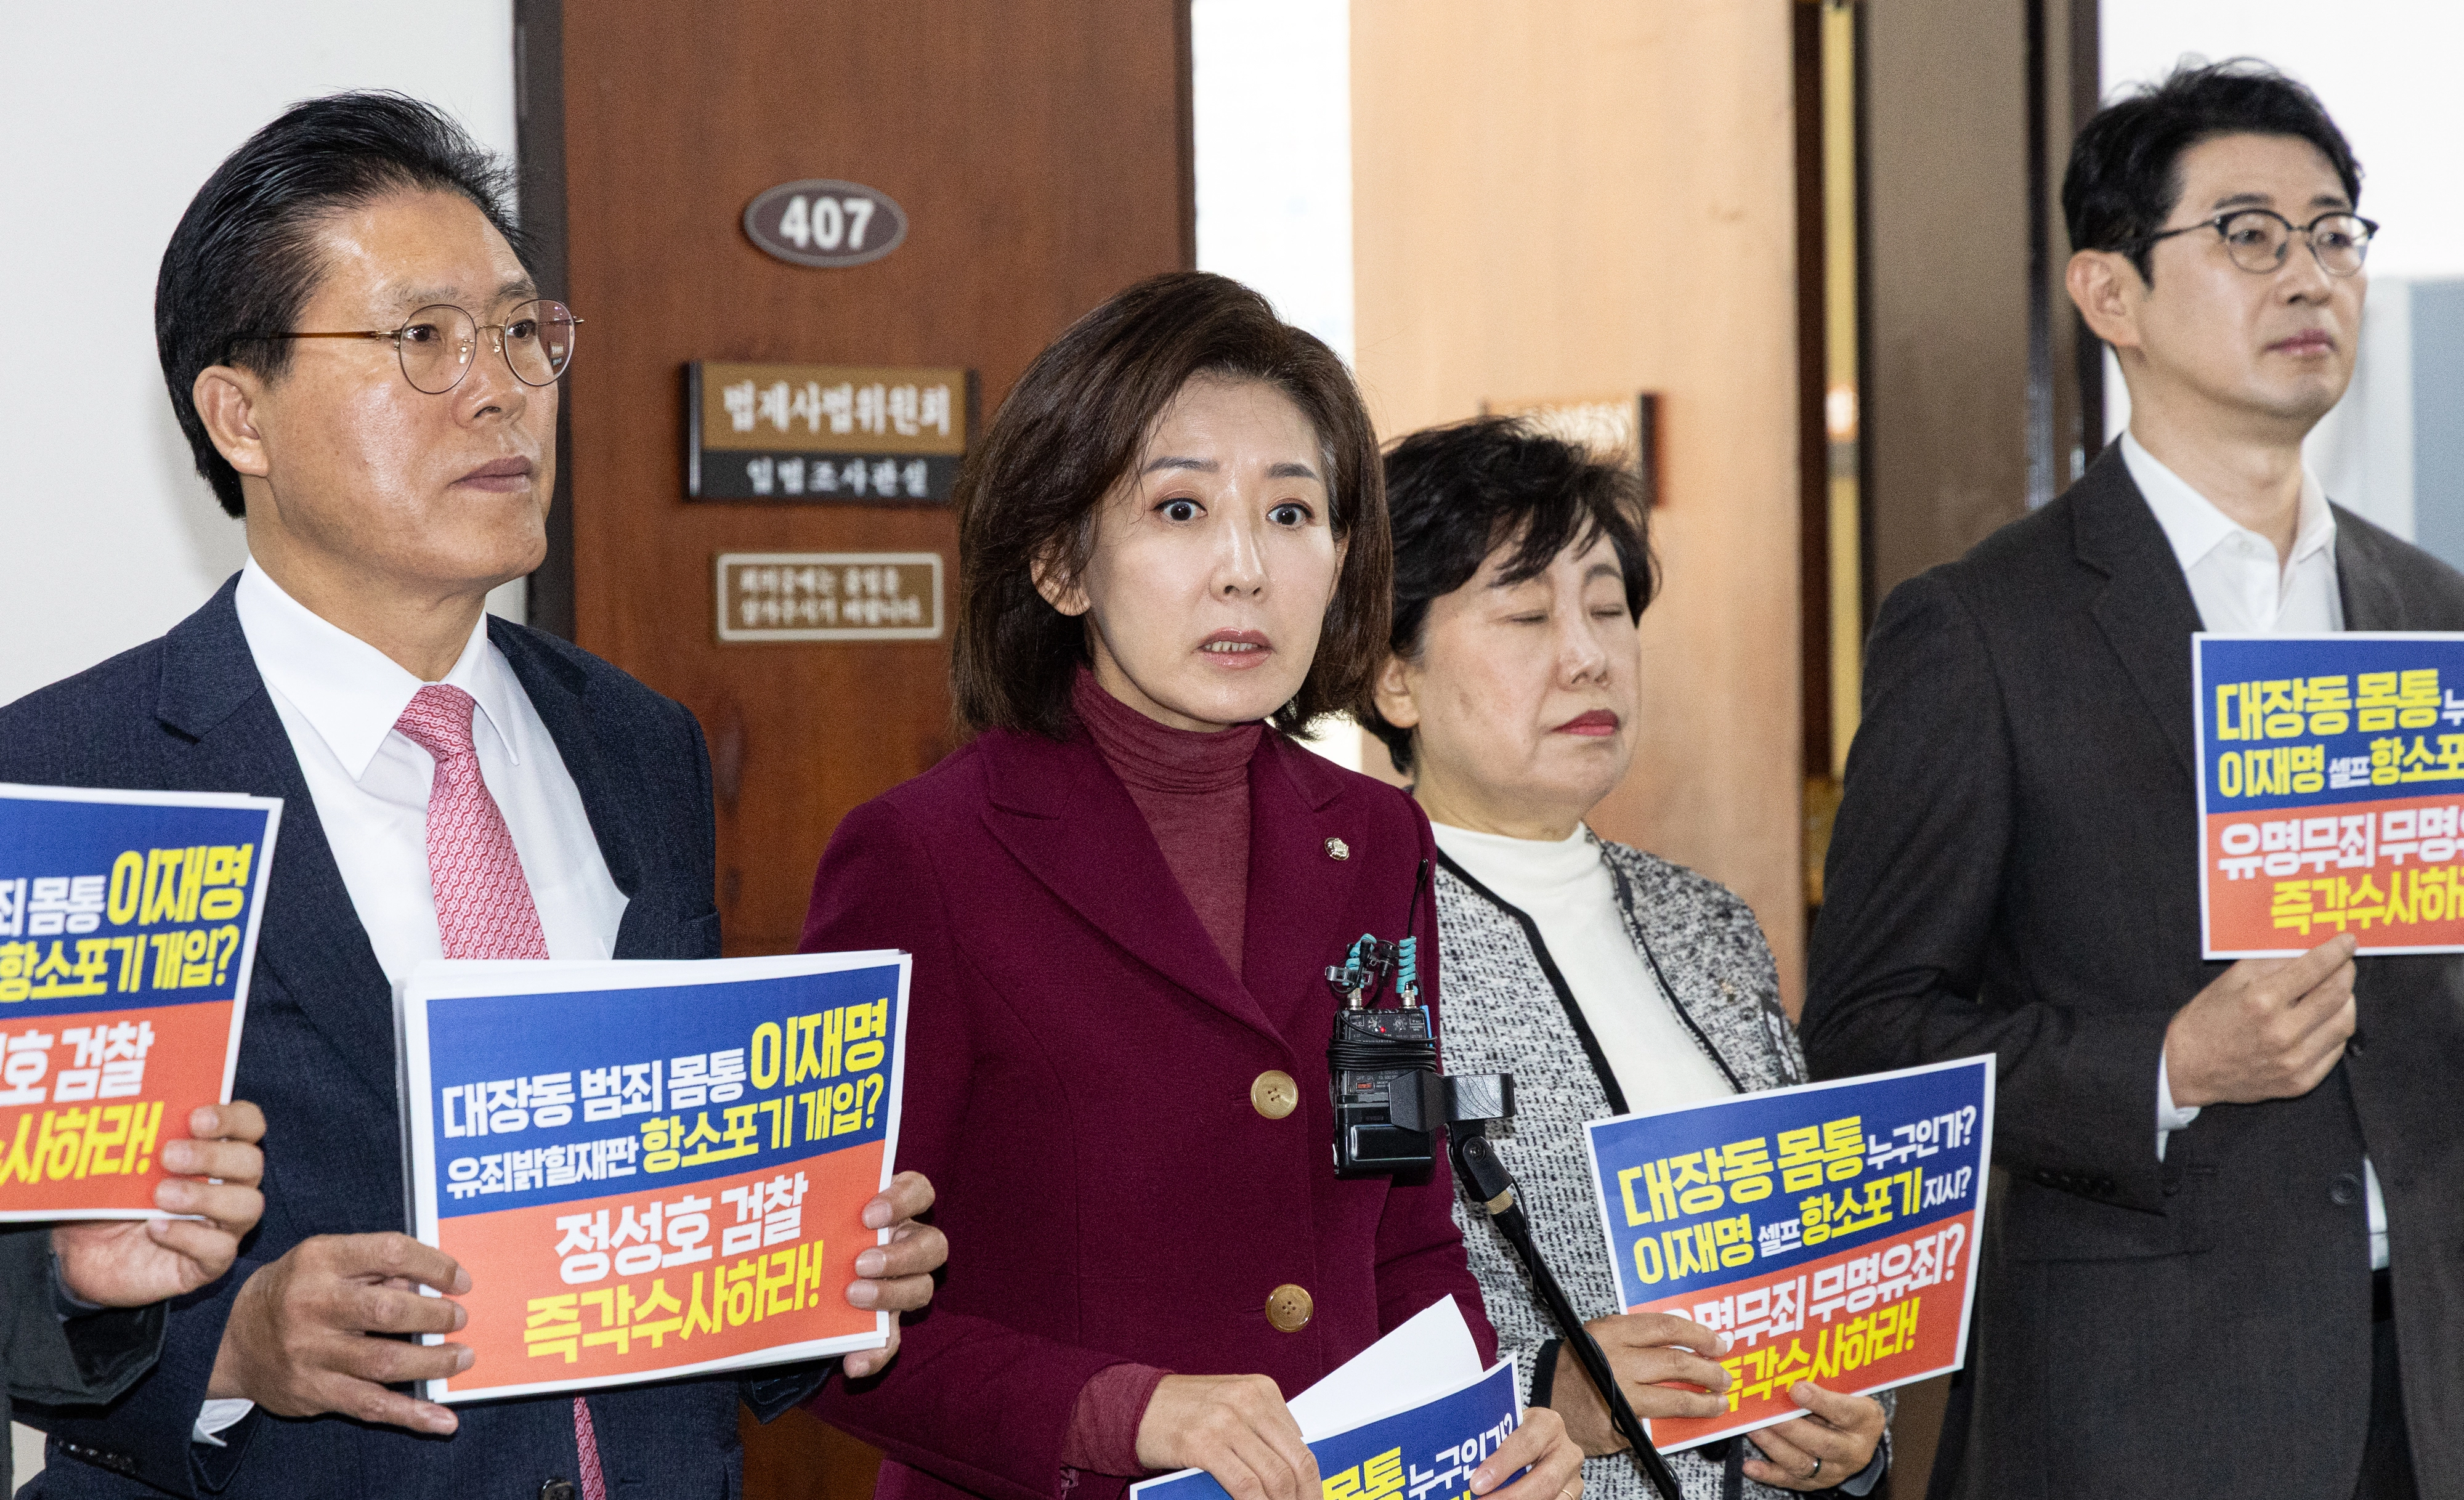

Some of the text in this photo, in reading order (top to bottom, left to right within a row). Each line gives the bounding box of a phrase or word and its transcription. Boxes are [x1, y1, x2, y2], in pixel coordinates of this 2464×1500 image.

[779, 197, 874, 249] 407
[723, 380, 950, 436] 법제사법위원회
[746, 456, 928, 497] 입법조사관실
[2217, 676, 2351, 740] 대장동
[2356, 669, 2441, 731] 몸통
[2219, 734, 2464, 797] 이재명 셀프 항소포
[2218, 805, 2464, 880] 유명무죄 무명
[28, 876, 106, 936] 몸통
[107, 843, 253, 925] 이재명
[2271, 865, 2464, 936] 즉각수사하
[0, 925, 240, 1002] 항소포기 개입?
[0, 1021, 155, 1106] 호 검찰
[442, 998, 888, 1138] 대장동 범죄 몸통 이재명
[0, 1101, 164, 1186] 사하라!
[446, 1073, 885, 1199] 유죄밝힐재판 항소포기 개입?
[1617, 1105, 1977, 1227] 대장동 몸통 누구인가?
[554, 1171, 809, 1285] 정성호 검찰
[1633, 1166, 1971, 1284] 이재명 셀프 항소포기 지시?
[523, 1239, 824, 1364] 즉각수사하라!
[1663, 1223, 1966, 1353] 명무죄 무명유죄?
